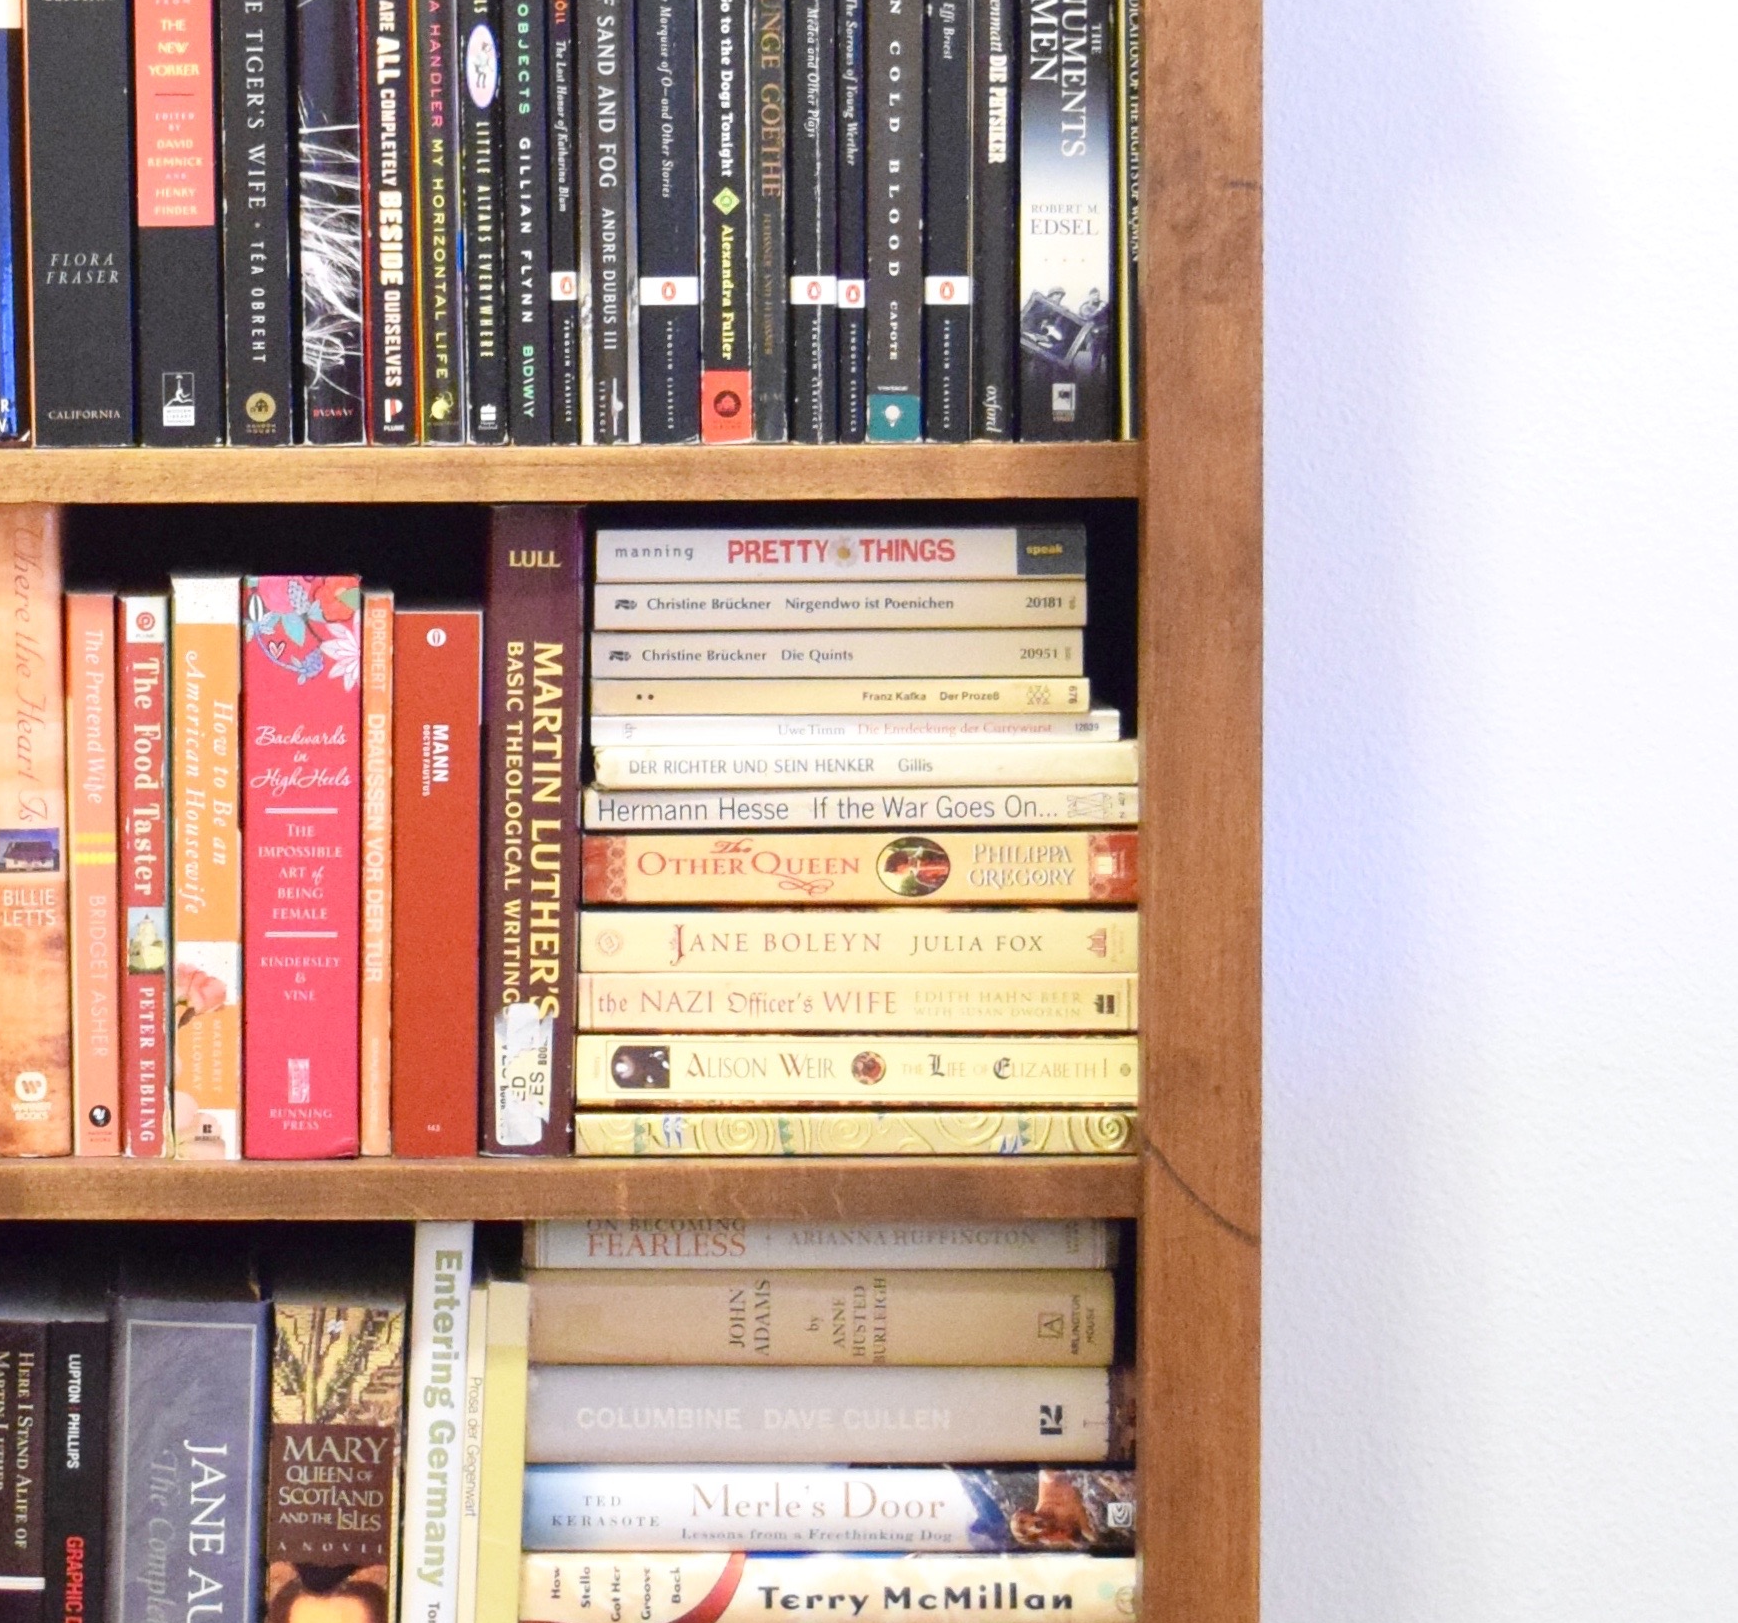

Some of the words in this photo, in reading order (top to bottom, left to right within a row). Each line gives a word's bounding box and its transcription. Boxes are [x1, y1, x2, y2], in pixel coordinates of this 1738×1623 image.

[1091, 23, 1102, 55] THE
[245, 27, 265, 131] TIGER'S
[888, 42, 900, 133] COLD
[248, 143, 267, 211] WIFE
[887, 159, 900, 277] BLOOD
[1031, 204, 1080, 214] ROBERT
[1031, 218, 1099, 236] EDSEL
[509, 550, 562, 568] LULL
[727, 540, 828, 564] PRETTY
[859, 539, 955, 563] THINGS
[647, 597, 706, 611] Christine
[711, 597, 771, 611] Brückner
[785, 597, 860, 613] Nirgendwo
[865, 597, 879, 610] ist
[884, 597, 954, 610] Poenichen
[1026, 597, 1063, 609] 20181
[598, 799, 708, 821] Hermann
[718, 798, 789, 820] Hesse
[812, 798, 830, 819] If
[836, 797, 874, 819] the
[882, 797, 929, 818] War
[936, 797, 995, 818] Goes
[185, 1439, 228, 1557] JANE
[759, 1586, 869, 1616] Terry
[883, 1585, 1074, 1610] McMillan
